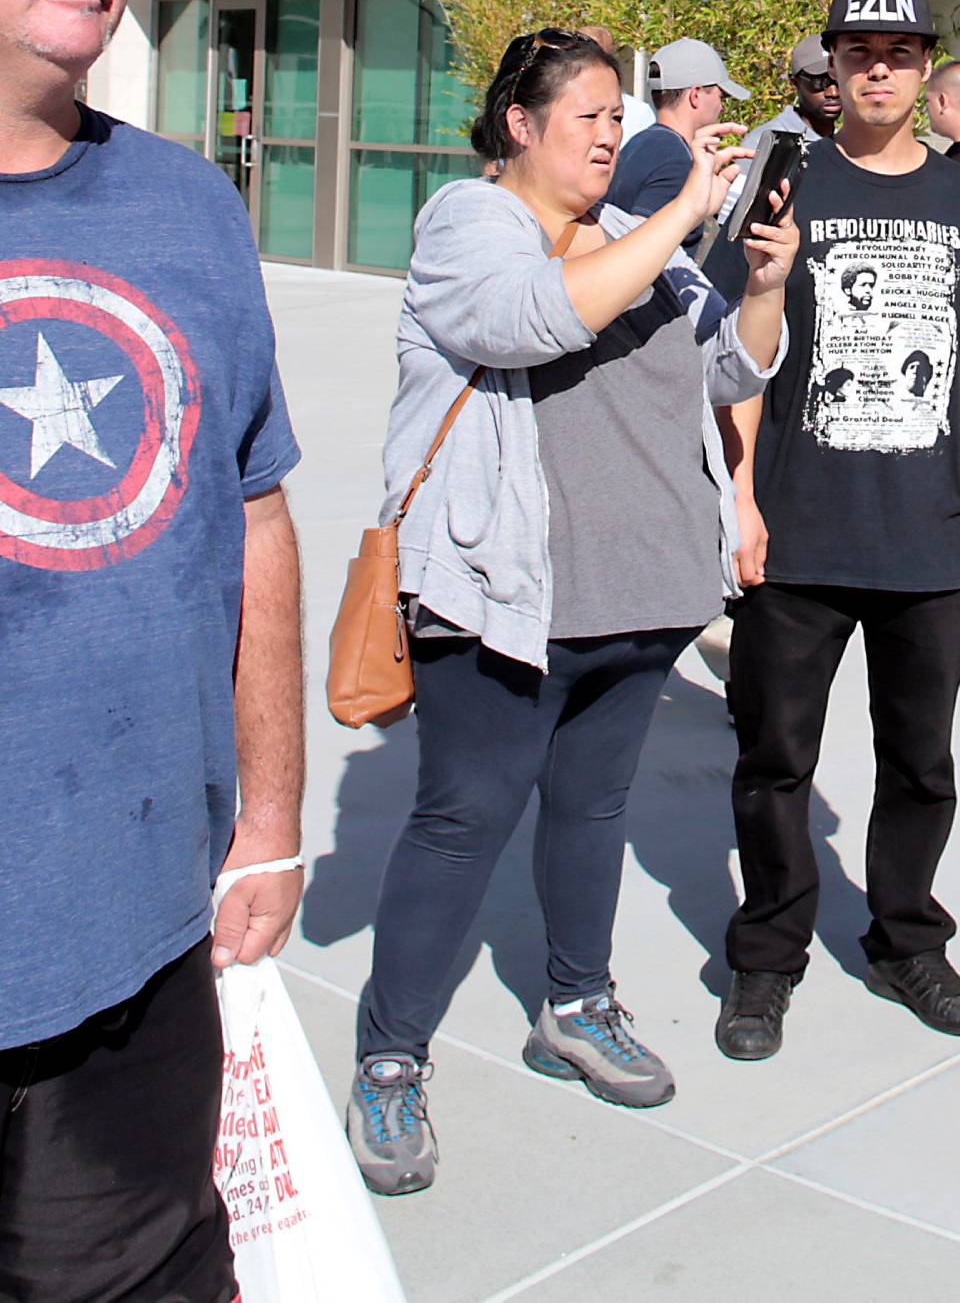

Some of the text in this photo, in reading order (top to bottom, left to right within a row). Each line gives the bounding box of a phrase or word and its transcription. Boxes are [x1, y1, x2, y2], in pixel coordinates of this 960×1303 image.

[922, 275, 945, 284] SEALE
[884, 301, 949, 312] ANGELA DAVIS
[921, 314, 950, 323] MAGEE
[842, 415, 880, 423] Grateful
